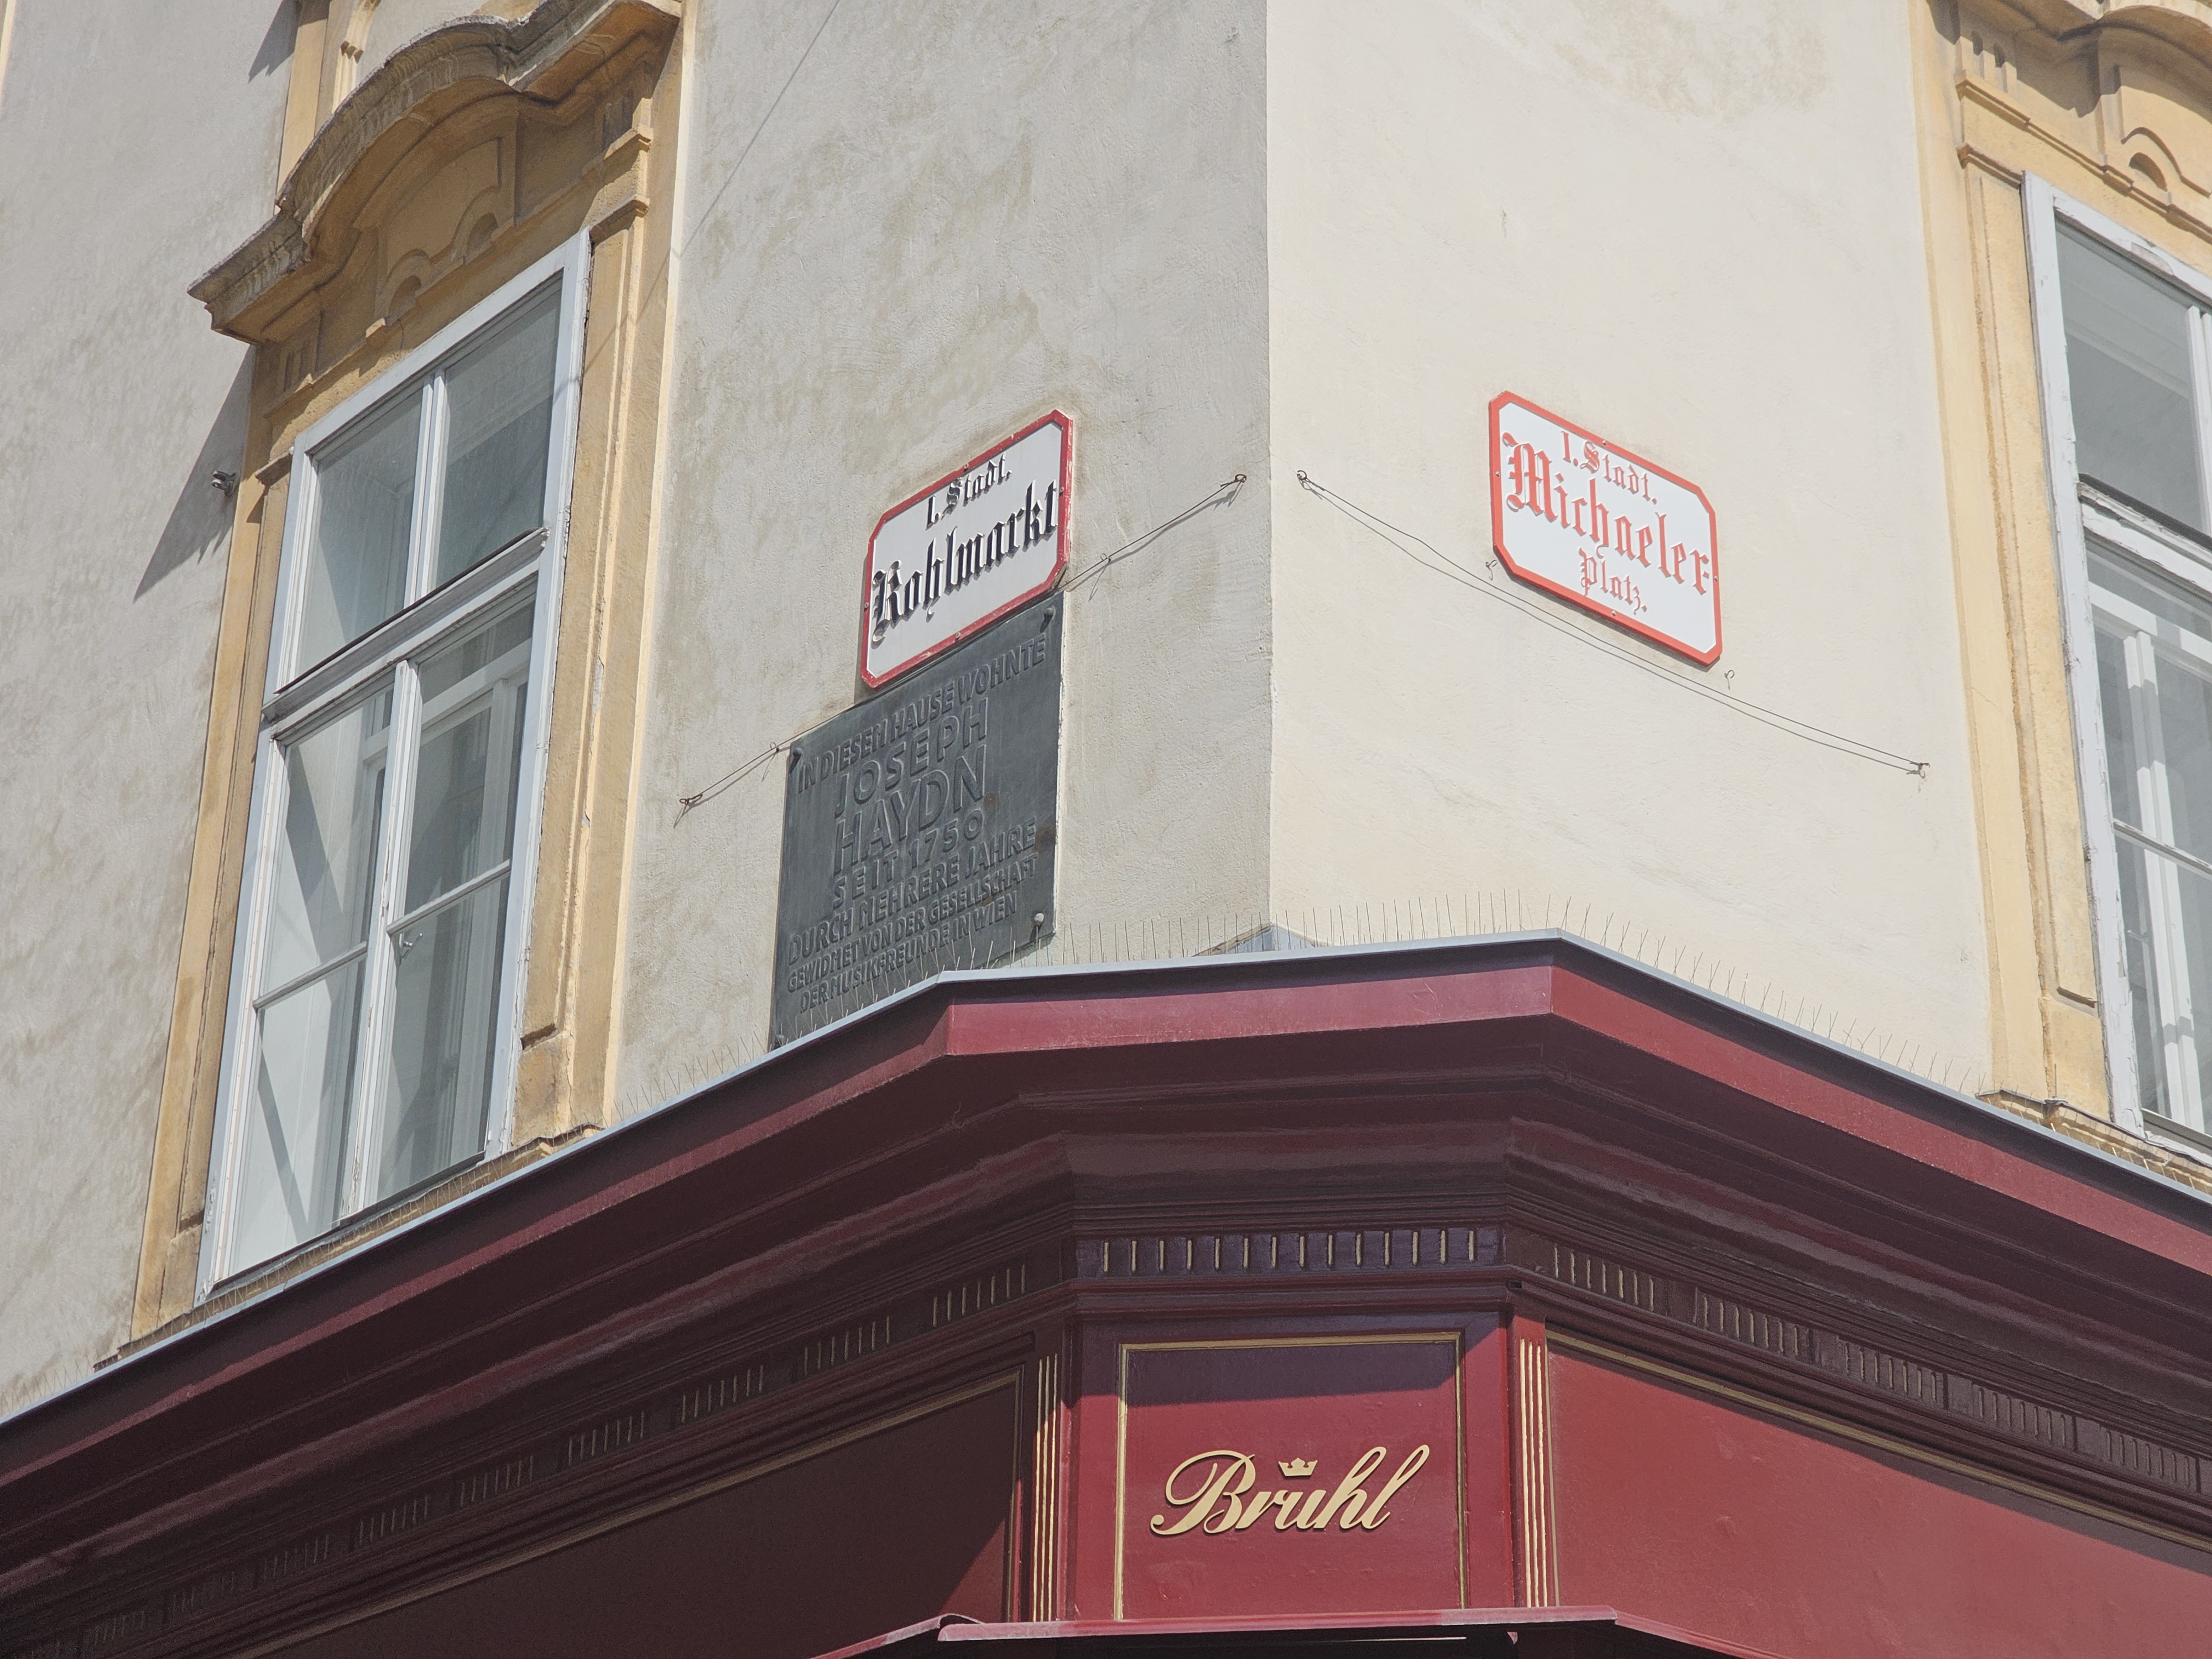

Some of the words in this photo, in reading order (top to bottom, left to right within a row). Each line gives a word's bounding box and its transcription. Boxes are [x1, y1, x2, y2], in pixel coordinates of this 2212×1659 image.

[945, 452, 1013, 507] Stadt.
[1580, 440, 1658, 505] Stadt.
[872, 479, 1058, 644] Kohlmarkt
[1578, 547, 1648, 615] Platz.
[798, 758, 816, 794] IN
[820, 719, 888, 781] DIESEM
[891, 681, 954, 743] HAUSE
[958, 629, 1046, 707] WOHNTE
[834, 696, 988, 818] JOSEPH
[833, 742, 987, 877] HAYDN
[833, 848, 898, 910] SEIT
[907, 805, 984, 871] 1750
[787, 937, 860, 994] GEWIDMET
[862, 922, 893, 958] VON
[895, 906, 926, 942] DER
[927, 852, 1037, 927] GESELLSCHAFT
[789, 906, 854, 966] DURCH
[858, 852, 960, 930] MEHRERE
[965, 815, 1036, 879] JAHRE
[800, 980, 829, 1013] DER
[830, 923, 950, 999] MUSIKFREUNDE
[953, 912, 971, 942] IN
[973, 889, 1018, 932] WIEN
